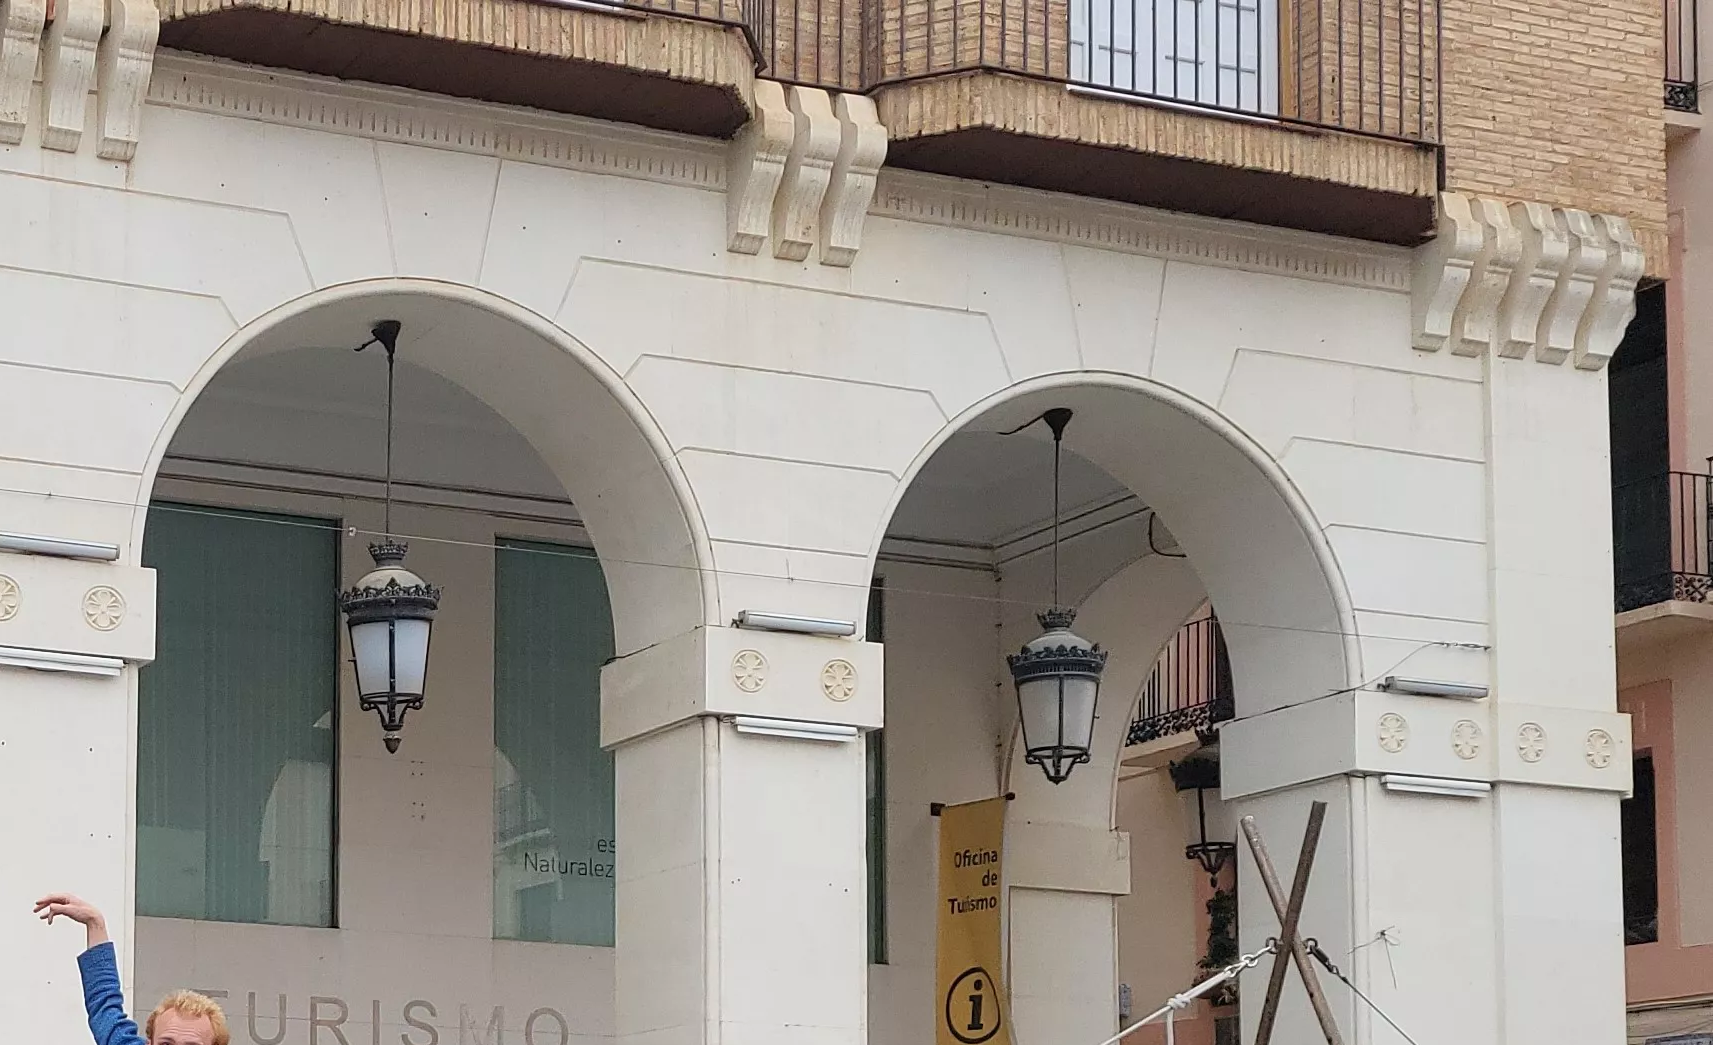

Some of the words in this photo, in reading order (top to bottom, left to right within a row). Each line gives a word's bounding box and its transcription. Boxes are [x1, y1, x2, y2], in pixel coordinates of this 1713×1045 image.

[524, 852, 614, 878] Naturalez
[953, 848, 998, 868] Oficina
[981, 869, 998, 887] de
